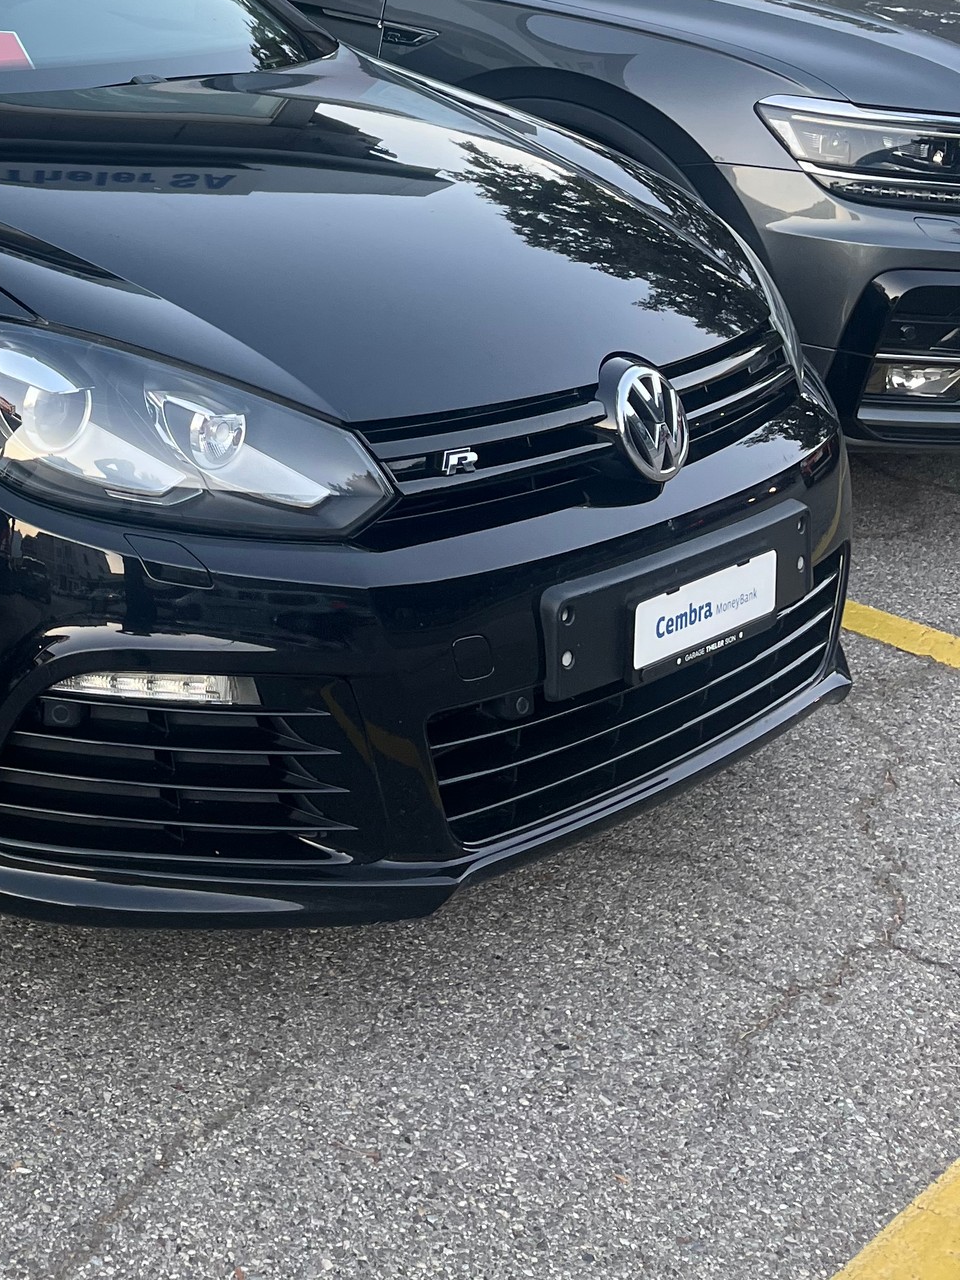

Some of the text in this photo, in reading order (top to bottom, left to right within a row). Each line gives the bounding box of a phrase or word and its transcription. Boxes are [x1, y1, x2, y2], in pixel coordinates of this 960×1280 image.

[442, 447, 478, 475] R
[656, 588, 758, 638] Cembra MoneyBank
[684, 635, 737, 662] GARAGE THELER SION
